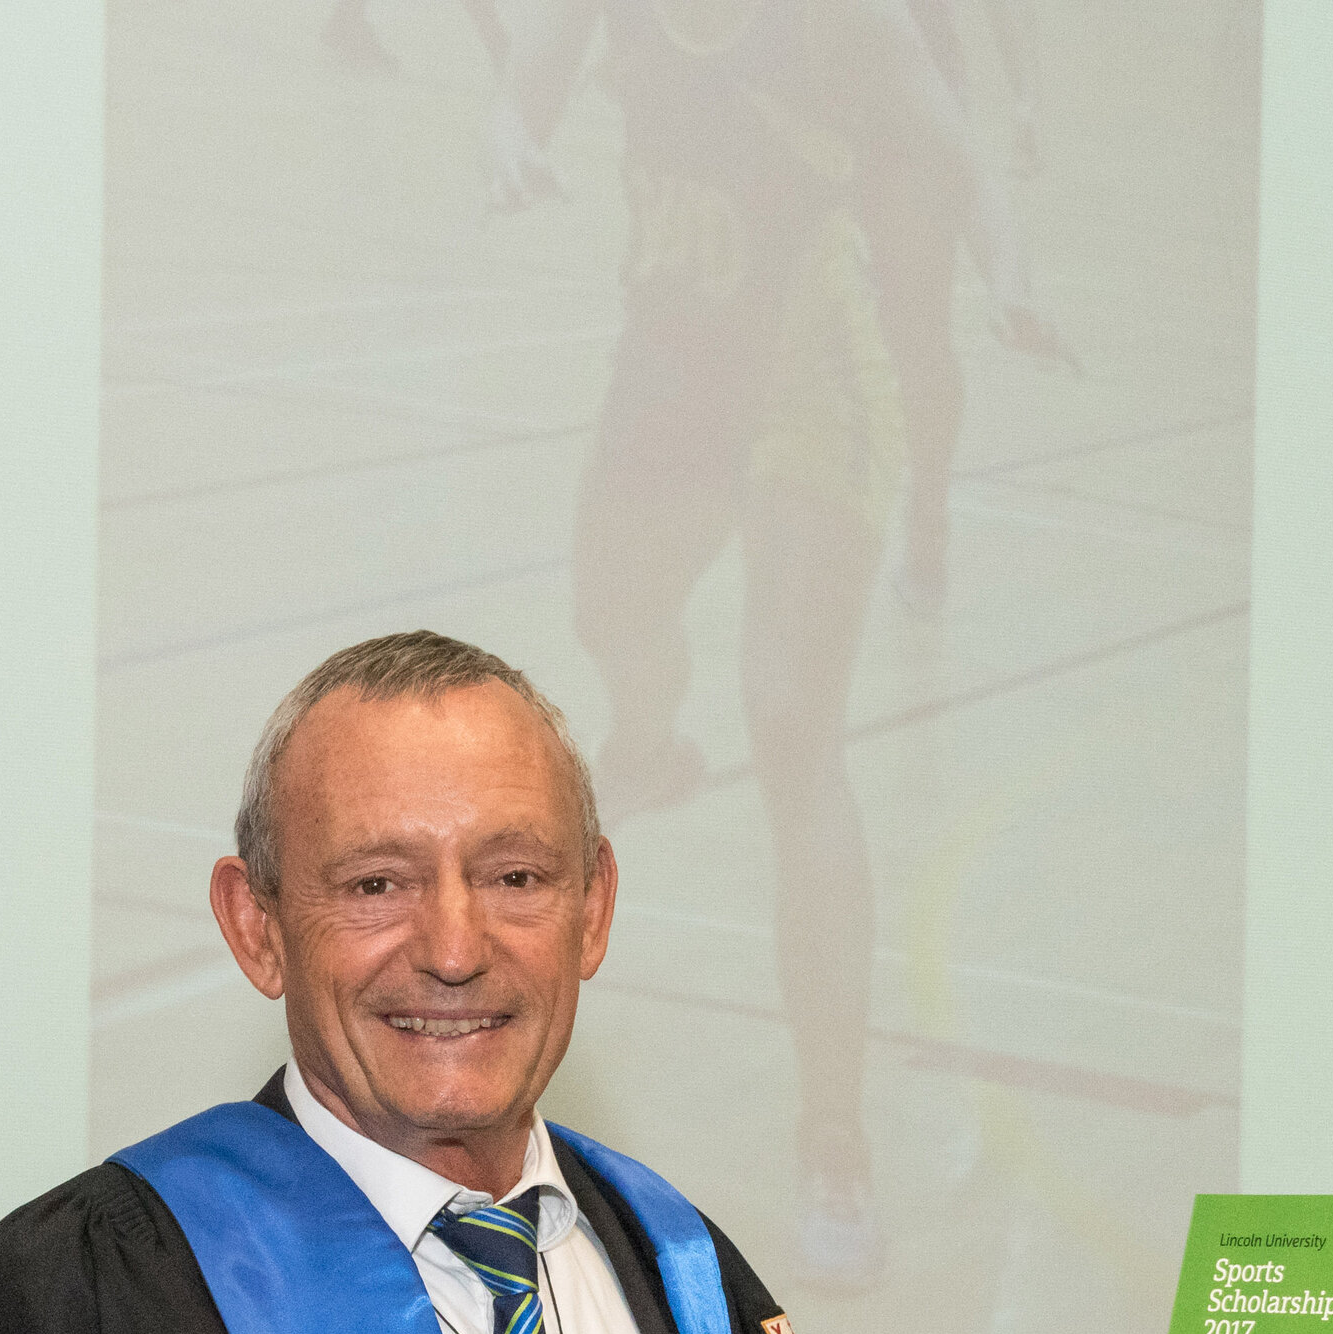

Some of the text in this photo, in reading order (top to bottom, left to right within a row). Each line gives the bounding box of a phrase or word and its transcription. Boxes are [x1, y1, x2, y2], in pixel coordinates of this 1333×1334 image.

[1220, 1233, 1327, 1251] Lincoln University
[1213, 1258, 1285, 1287] Sports
